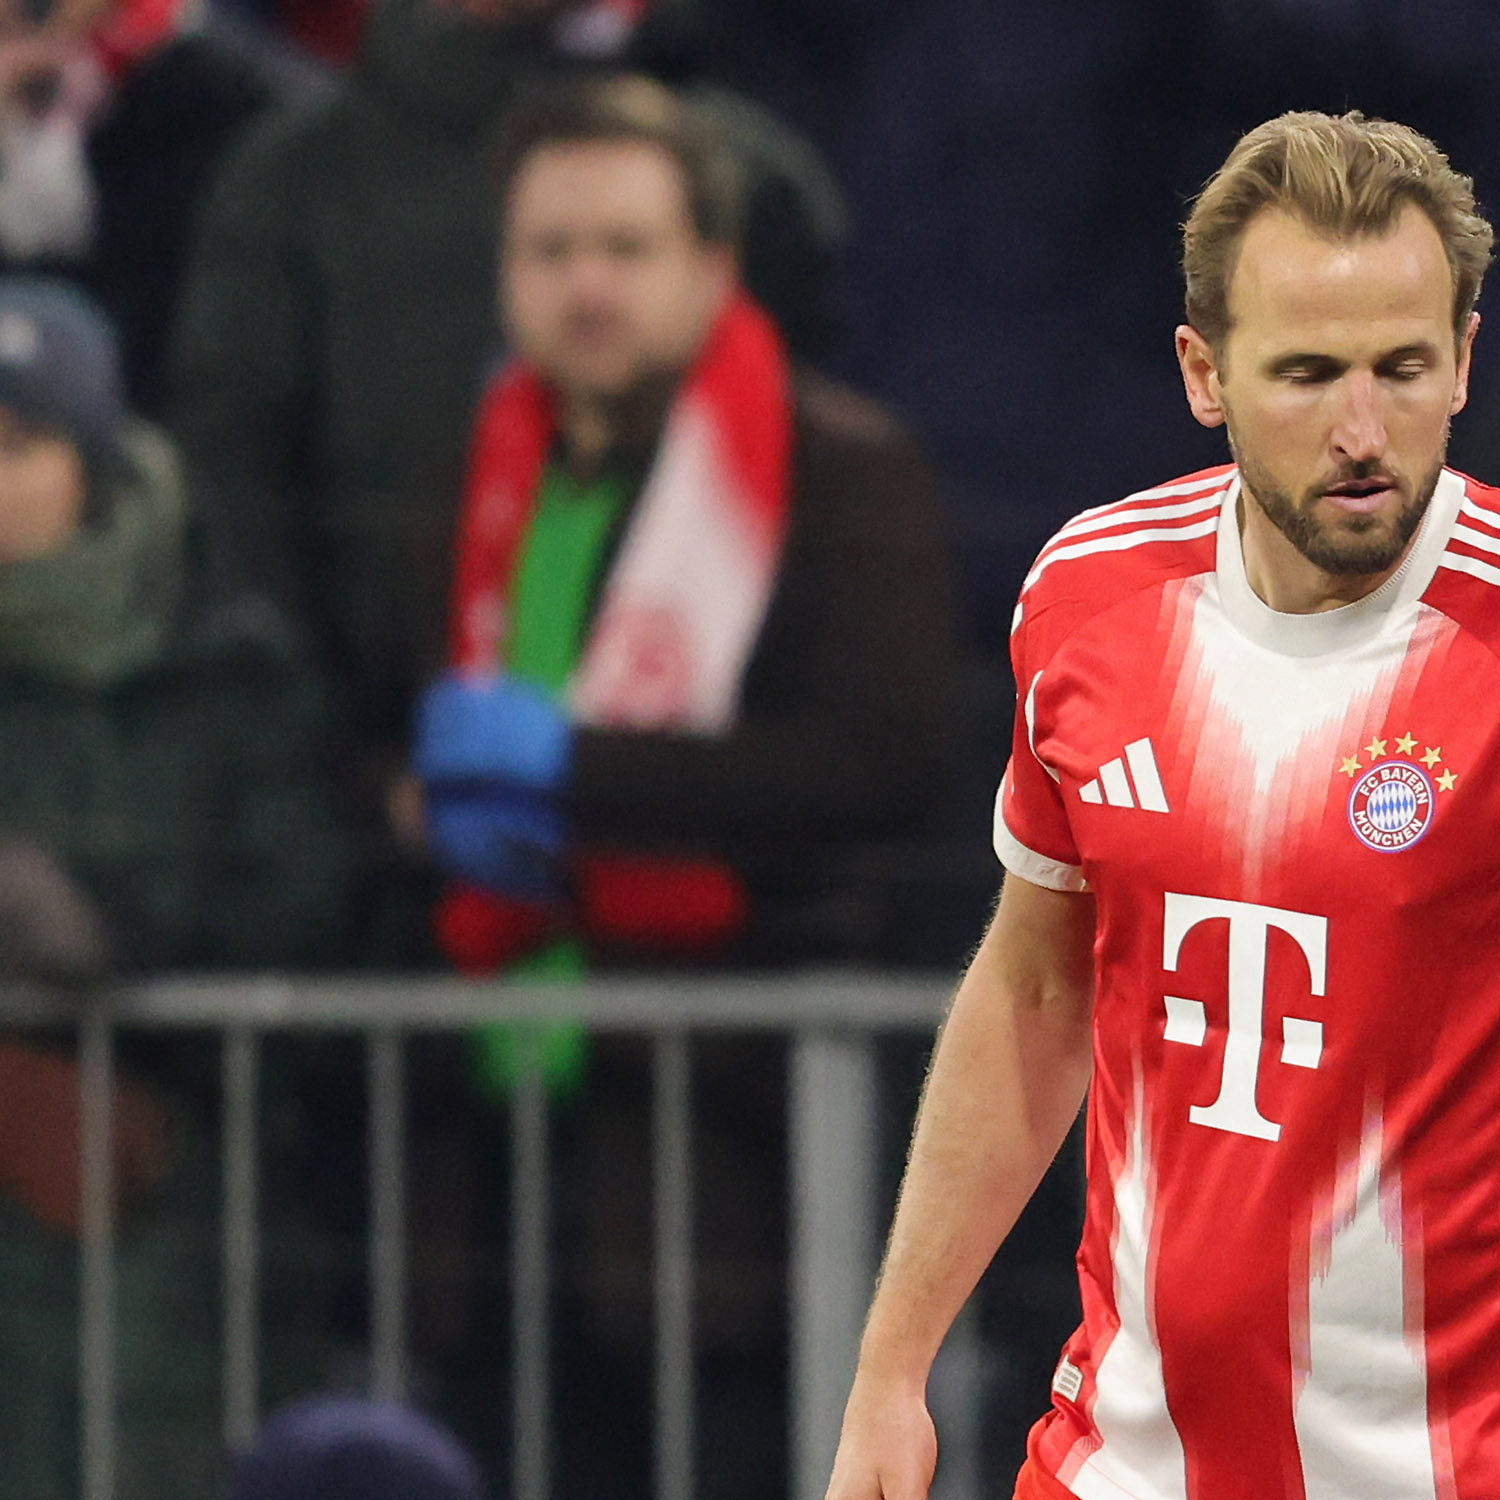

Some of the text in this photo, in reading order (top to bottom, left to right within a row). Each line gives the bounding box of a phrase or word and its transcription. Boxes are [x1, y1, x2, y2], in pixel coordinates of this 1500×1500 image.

[1360, 768, 1429, 805] FC BAYERN
[1163, 892, 1328, 1142] T
